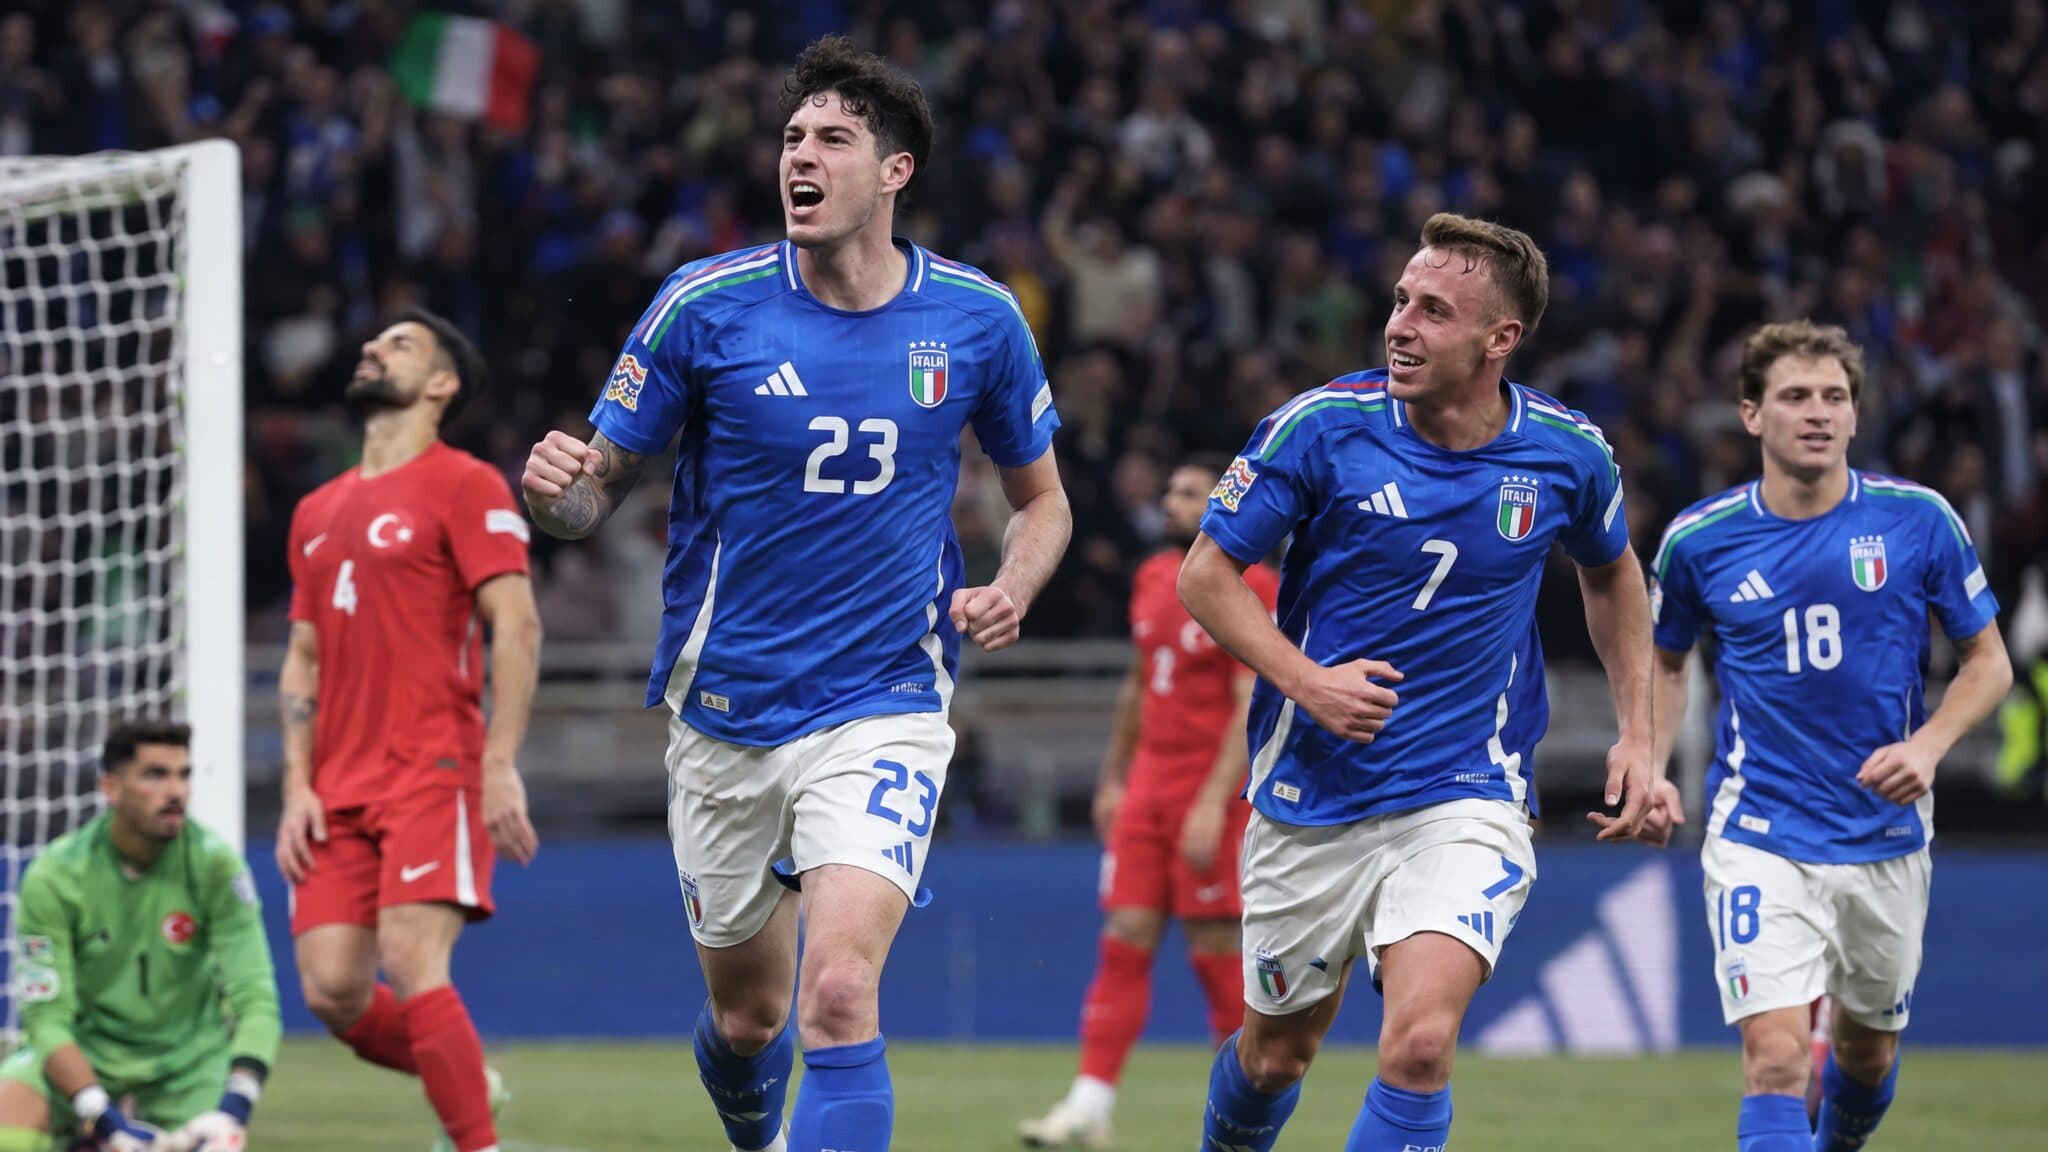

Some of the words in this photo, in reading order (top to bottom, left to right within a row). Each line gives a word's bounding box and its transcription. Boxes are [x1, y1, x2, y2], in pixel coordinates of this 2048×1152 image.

[804, 416, 899, 495] 23
[333, 560, 357, 615] 4
[1411, 539, 1458, 611] 7
[1783, 605, 1843, 673] 18
[867, 758, 938, 837] 23
[1482, 855, 1526, 899] 7
[1717, 886, 1761, 951] 18
[138, 953, 149, 999] 1
